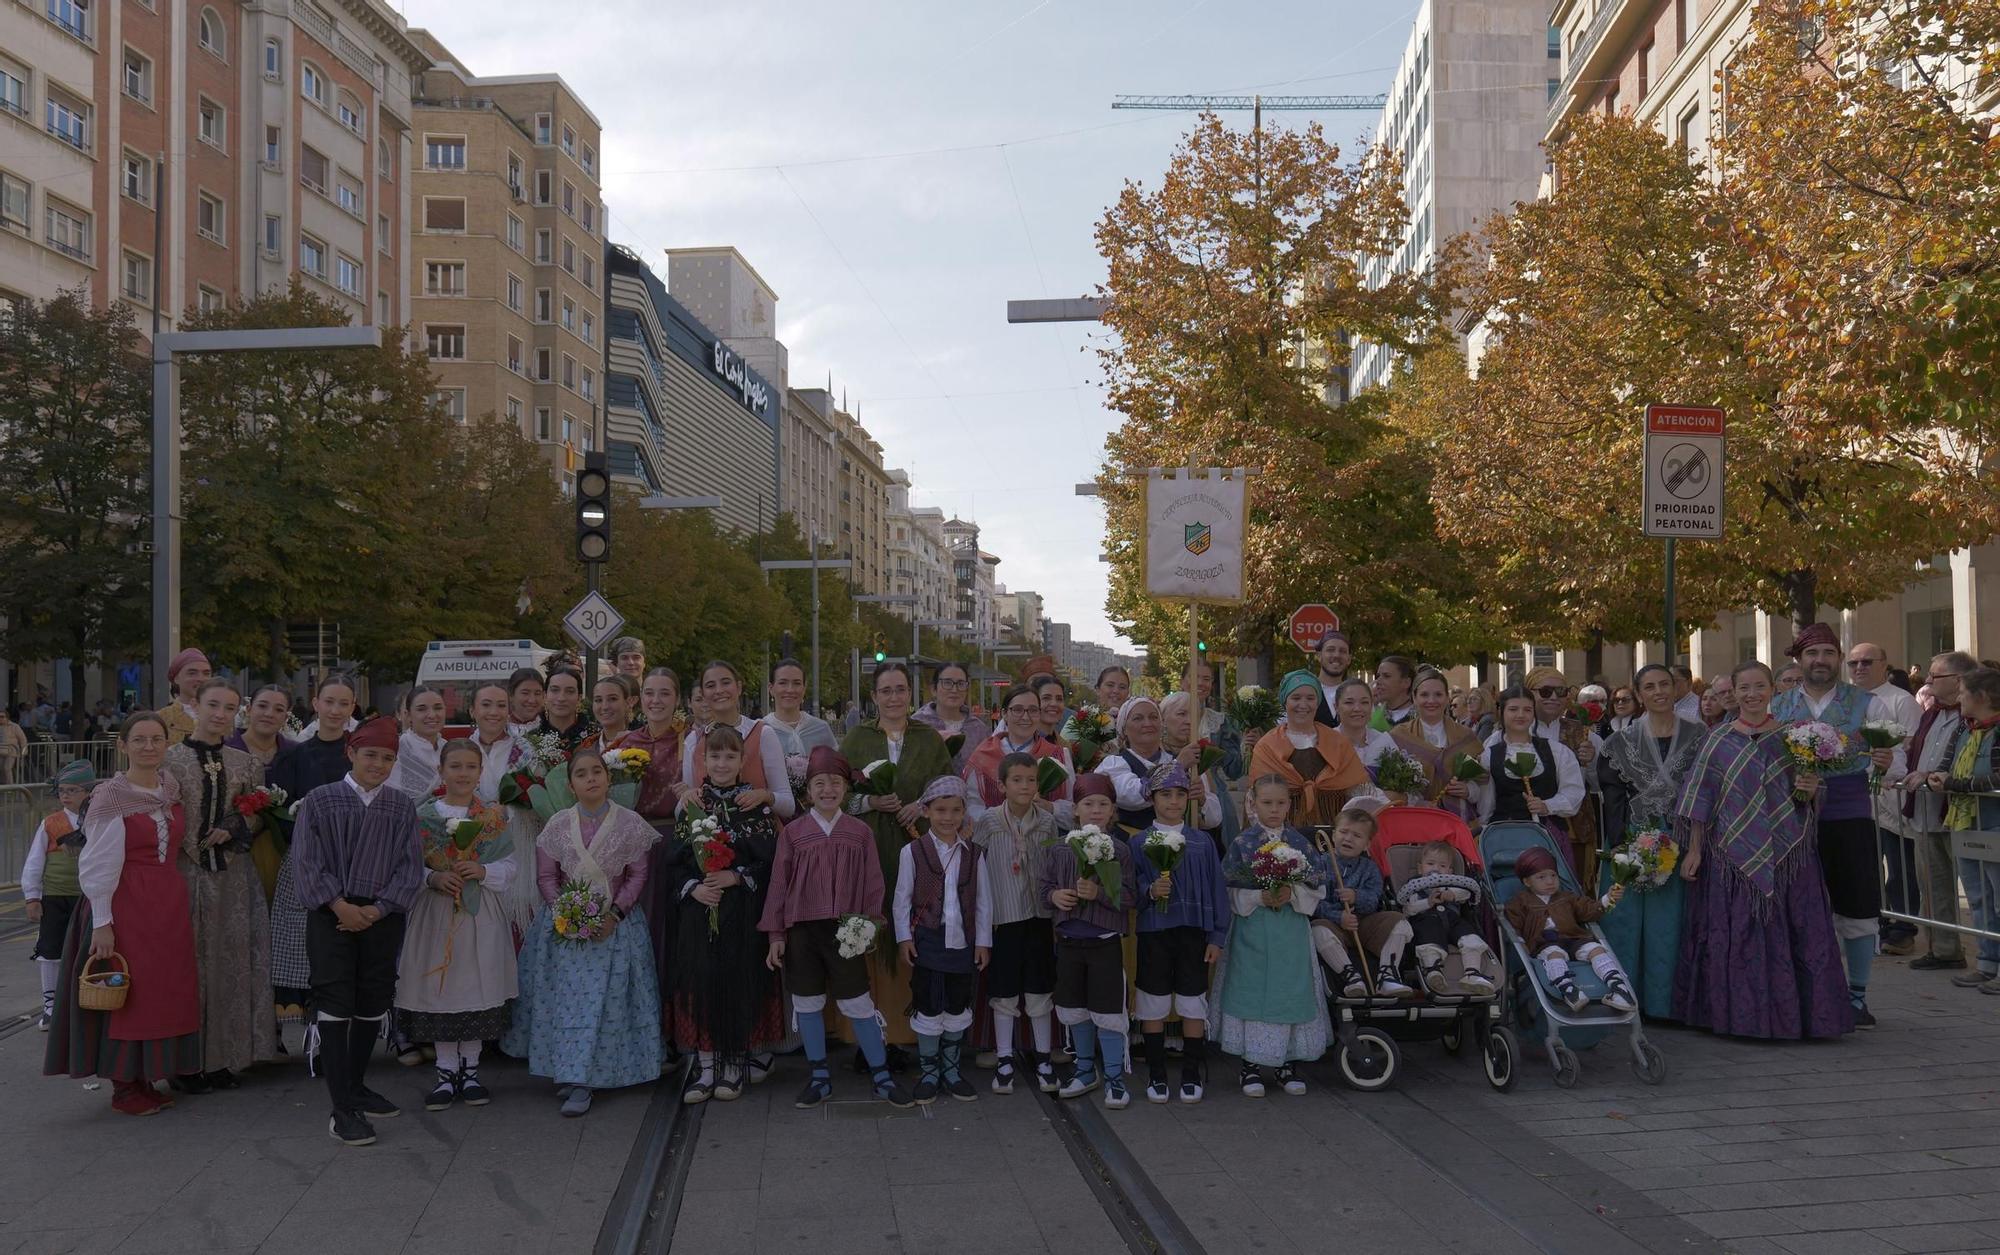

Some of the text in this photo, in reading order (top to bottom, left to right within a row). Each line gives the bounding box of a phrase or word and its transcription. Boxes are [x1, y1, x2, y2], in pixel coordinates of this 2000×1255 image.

[714, 341, 724, 375] El
[725, 352, 744, 391] Corte
[1657, 415, 1715, 427] ATENCIÓN
[1655, 503, 1716, 515] PRIORIDAD
[1655, 519, 1714, 530] PEATONAL
[1174, 563, 1225, 580] ZARAGOZA
[581, 610, 607, 630] 30
[1296, 622, 1333, 634] STOP
[434, 660, 520, 672] AMBULANCIA
